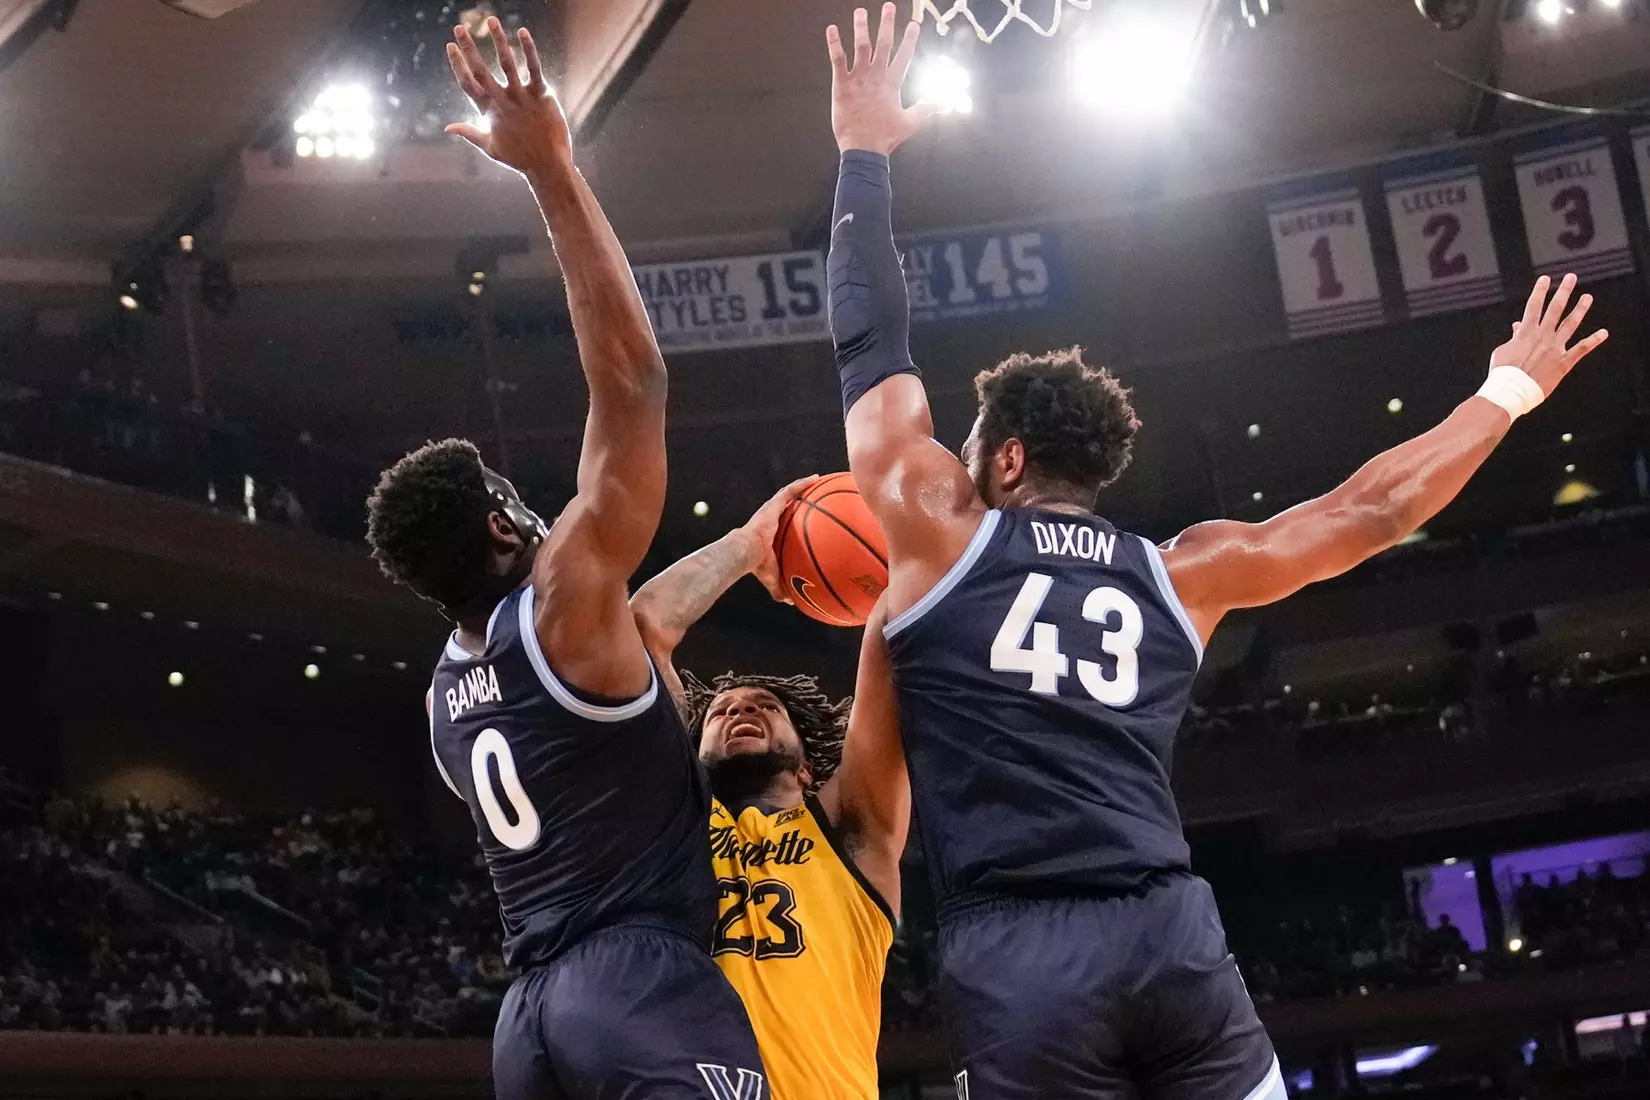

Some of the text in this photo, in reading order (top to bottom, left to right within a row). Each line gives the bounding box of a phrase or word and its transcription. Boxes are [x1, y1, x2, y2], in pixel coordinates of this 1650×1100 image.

[1422, 213, 1469, 278] 2
[1550, 185, 1595, 250] 3
[634, 264, 729, 297] HARRY
[757, 257, 821, 319] 15
[944, 232, 1048, 304] 145
[1309, 236, 1343, 300] 1
[648, 293, 746, 330] TYLES
[1030, 521, 1116, 565] DIXON
[990, 572, 1144, 707] 43
[446, 664, 503, 723] BAMBA
[471, 727, 541, 850] 0
[712, 876, 807, 960] 23
